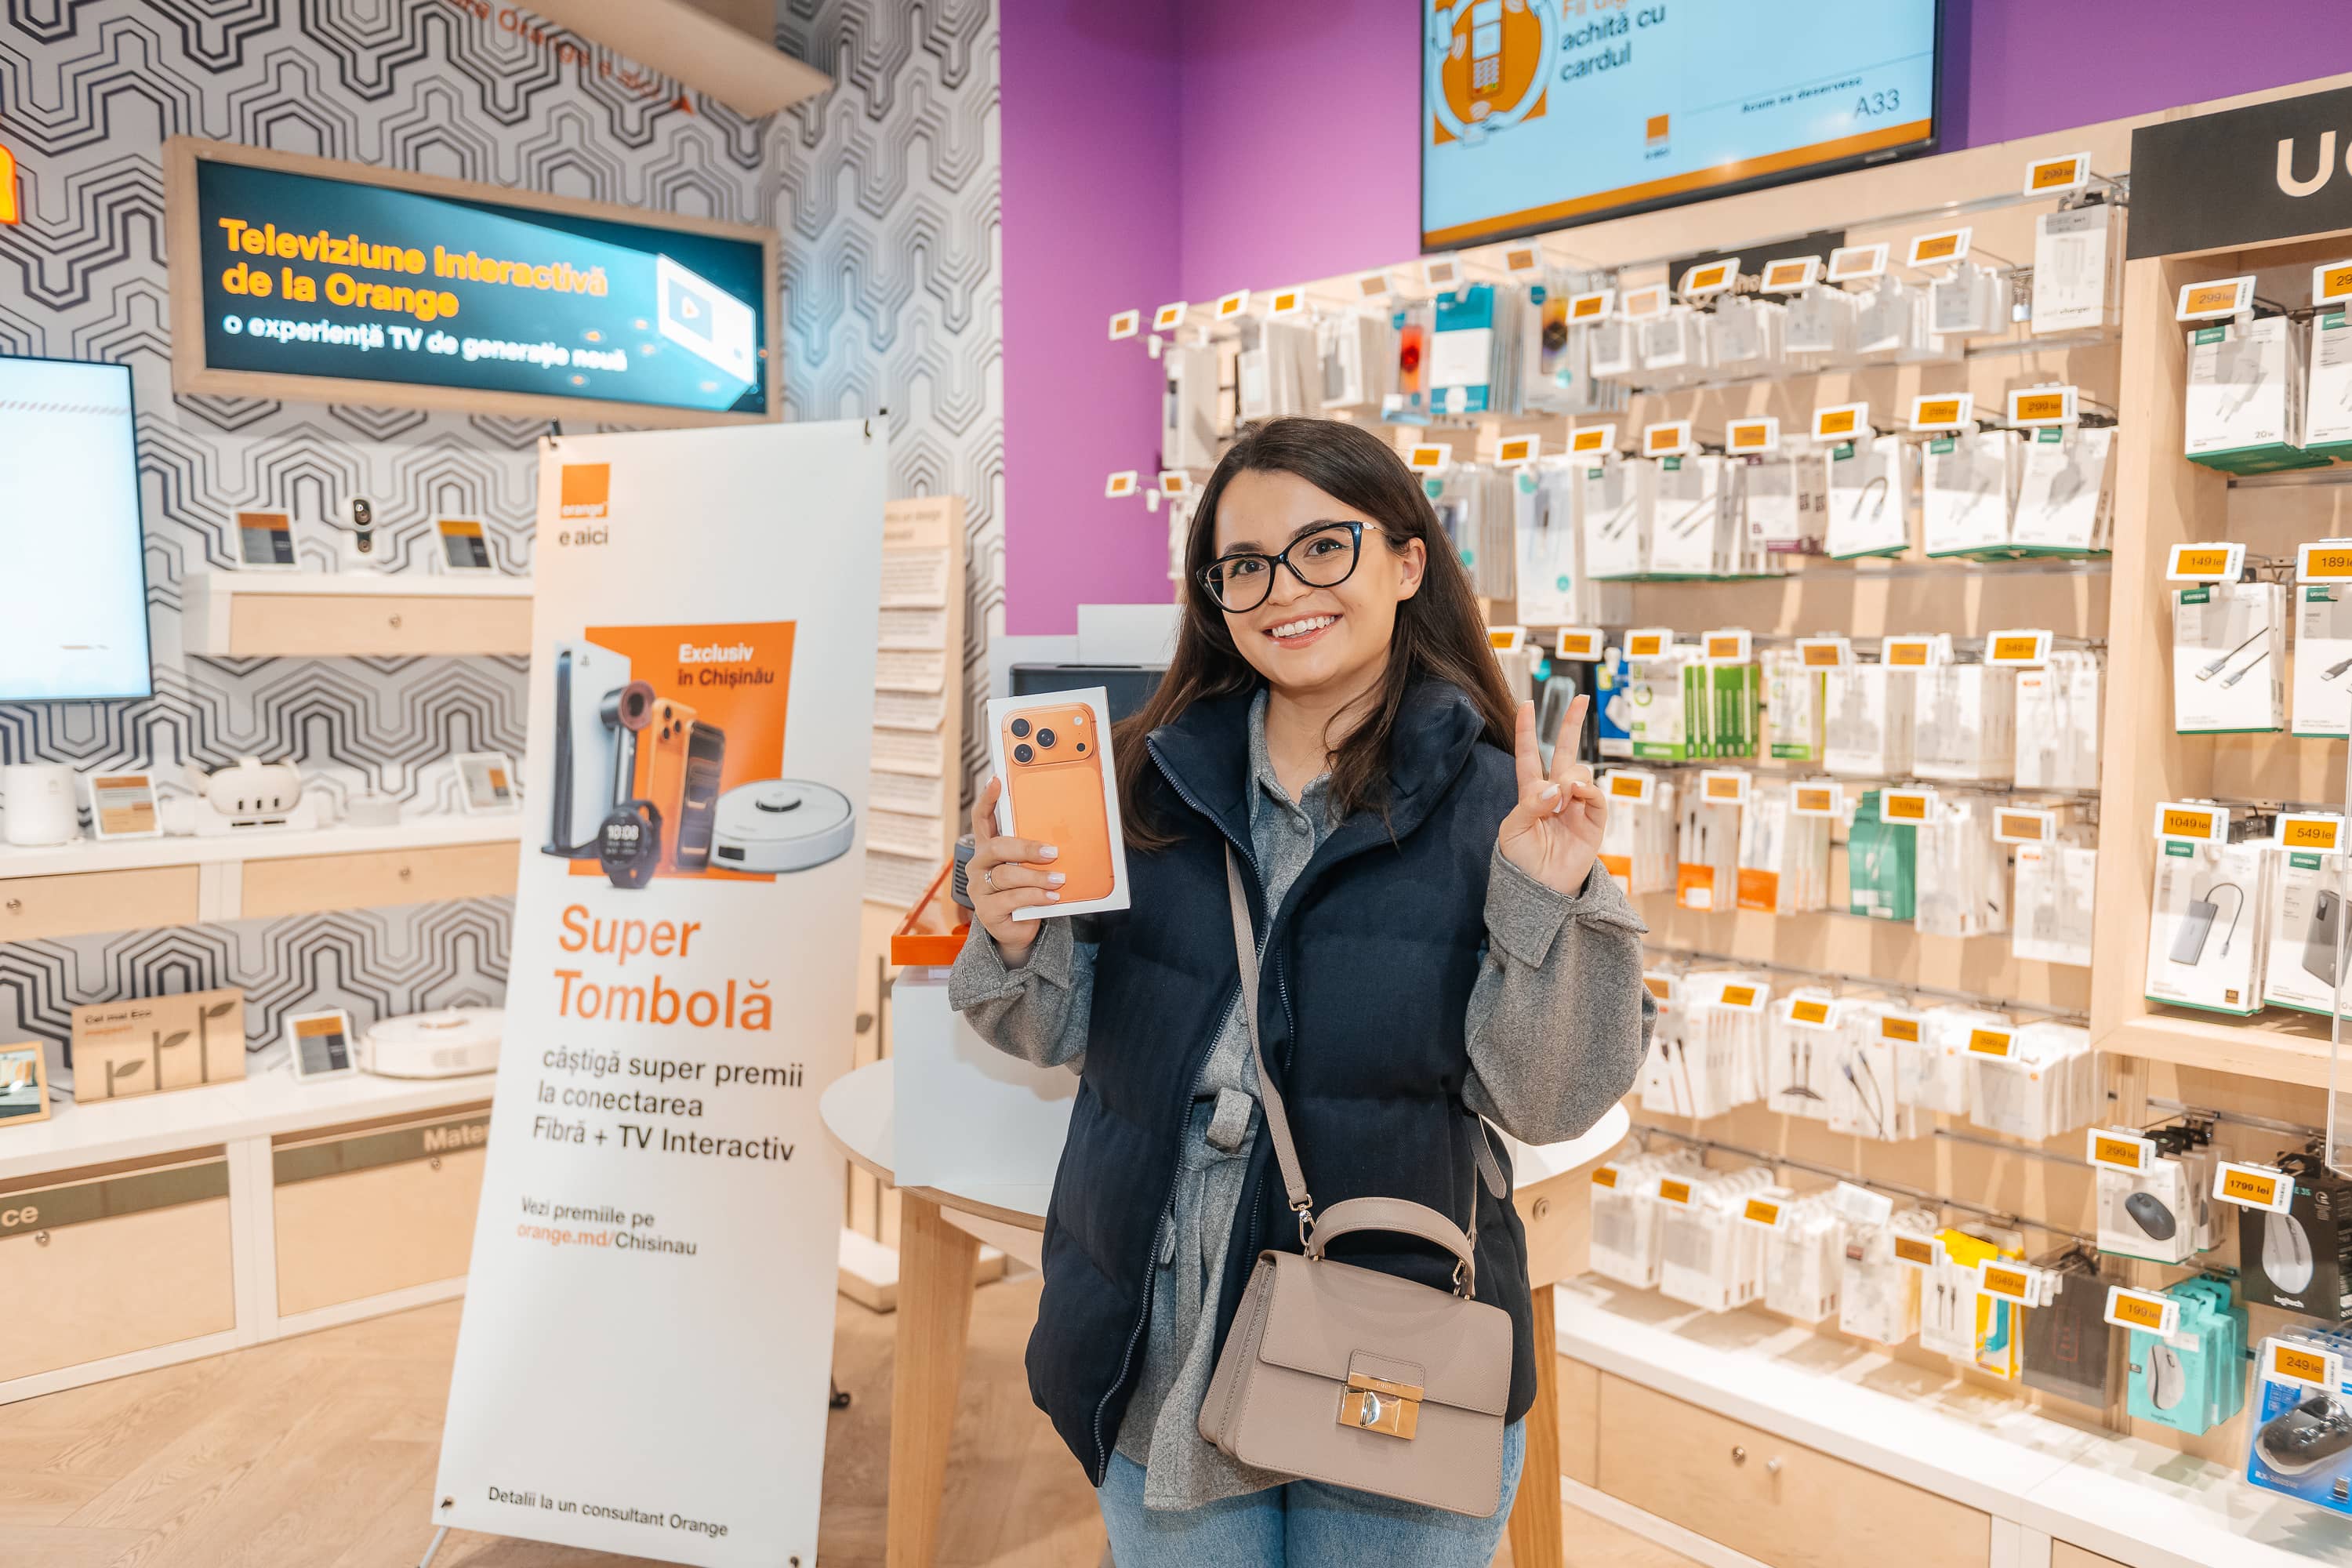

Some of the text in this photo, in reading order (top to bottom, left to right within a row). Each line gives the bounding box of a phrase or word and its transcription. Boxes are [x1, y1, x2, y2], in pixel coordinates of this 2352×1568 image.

[1637, 5, 1665, 27] cu
[1560, 41, 1631, 82] cardul
[1853, 88, 1900, 118] A33
[2276, 130, 2352, 197] U
[219, 217, 608, 297] Televiziune Interactivă
[222, 262, 459, 321] de la Orange
[2198, 292, 2220, 305] 299
[223, 314, 627, 372] o experiență TV de generație nouă
[559, 524, 608, 546] e aici
[2190, 557, 2212, 566] 149
[2321, 557, 2344, 568] 189
[678, 643, 753, 662] Exclusiv
[678, 667, 775, 690] în Chișinău
[2169, 816, 2197, 829] 1049
[2297, 827, 2320, 839] 549
[558, 904, 700, 965] Super
[554, 969, 773, 1031] Tombolă
[543, 1045, 804, 1088] câștigă super premii
[538, 1080, 703, 1117] la conectarea
[533, 1116, 795, 1162] Fibră + TV Interactiv
[2228, 1178, 2270, 1196] 1799 lei
[521, 1196, 655, 1228] Vezi premiile pe
[517, 1224, 697, 1255] orange.md/Chisinau
[2127, 1302, 2148, 1317] 199
[2286, 1356, 2310, 1372] 249
[488, 1486, 728, 1538] Detalii la un consultant Orange
